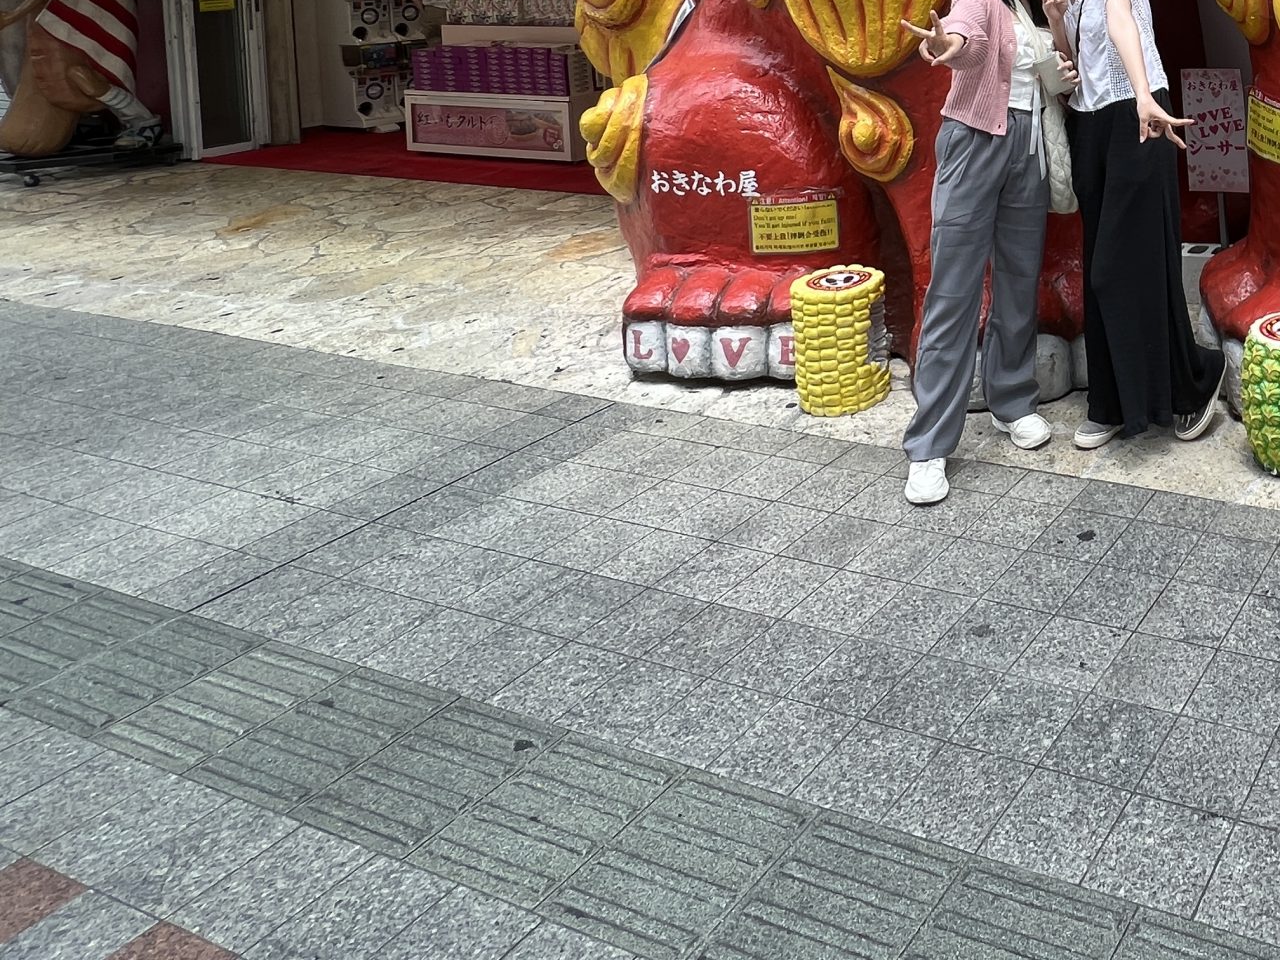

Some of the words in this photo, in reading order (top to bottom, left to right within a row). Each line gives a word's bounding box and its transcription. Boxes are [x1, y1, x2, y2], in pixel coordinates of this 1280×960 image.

[1187, 80, 1239, 91] おきなわ屋
[1189, 139, 1245, 156] シーサー
[650, 169, 761, 197] おきなわ屋
